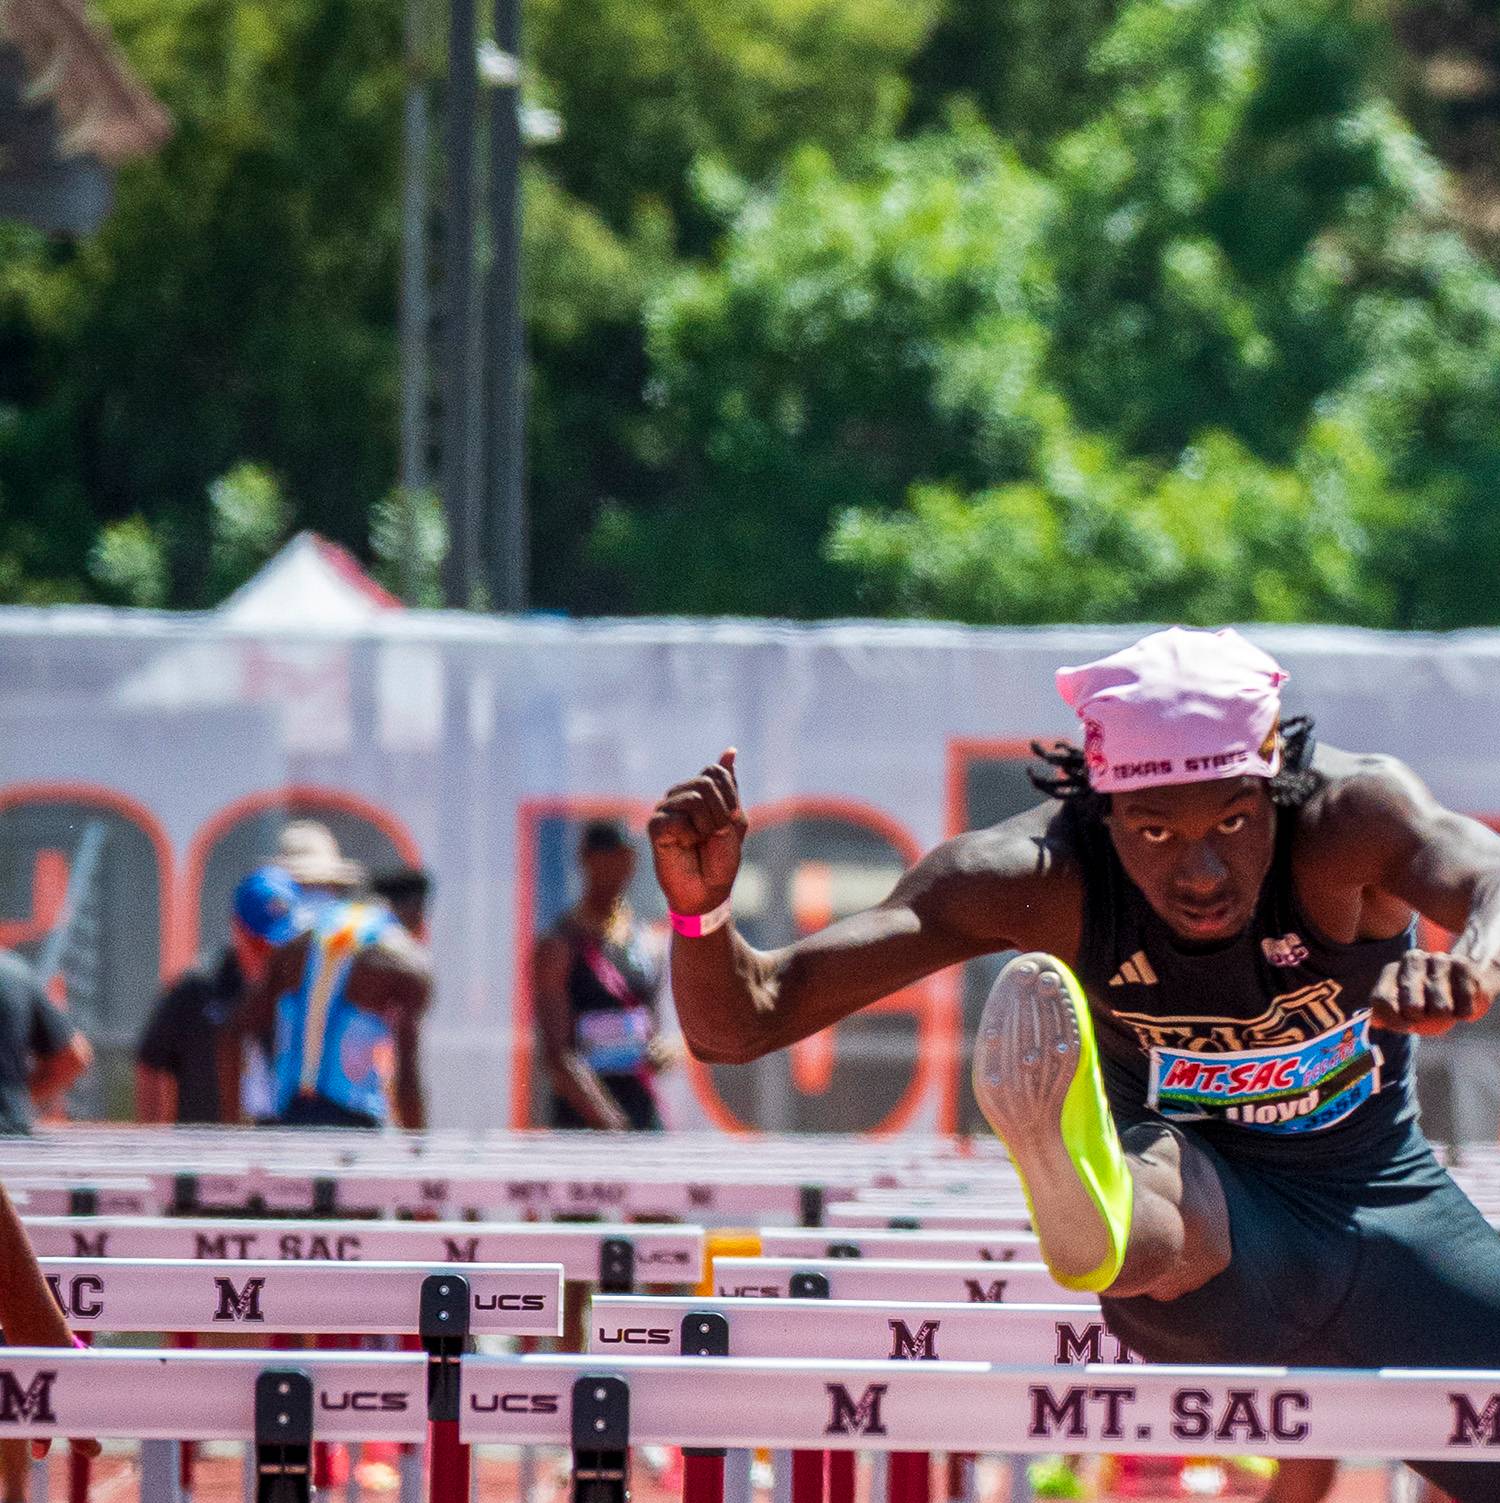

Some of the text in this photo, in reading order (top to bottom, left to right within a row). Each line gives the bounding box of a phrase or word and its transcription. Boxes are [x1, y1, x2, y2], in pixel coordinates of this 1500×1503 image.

[212, 1276, 266, 1322] M
[474, 1294, 545, 1311] UCS
[600, 1328, 672, 1345] UCS
[0, 1371, 57, 1424] M
[320, 1391, 408, 1412] UCS
[470, 1393, 558, 1414] UCS
[825, 1383, 888, 1436] M
[1029, 1385, 1311, 1443] MT. SAC
